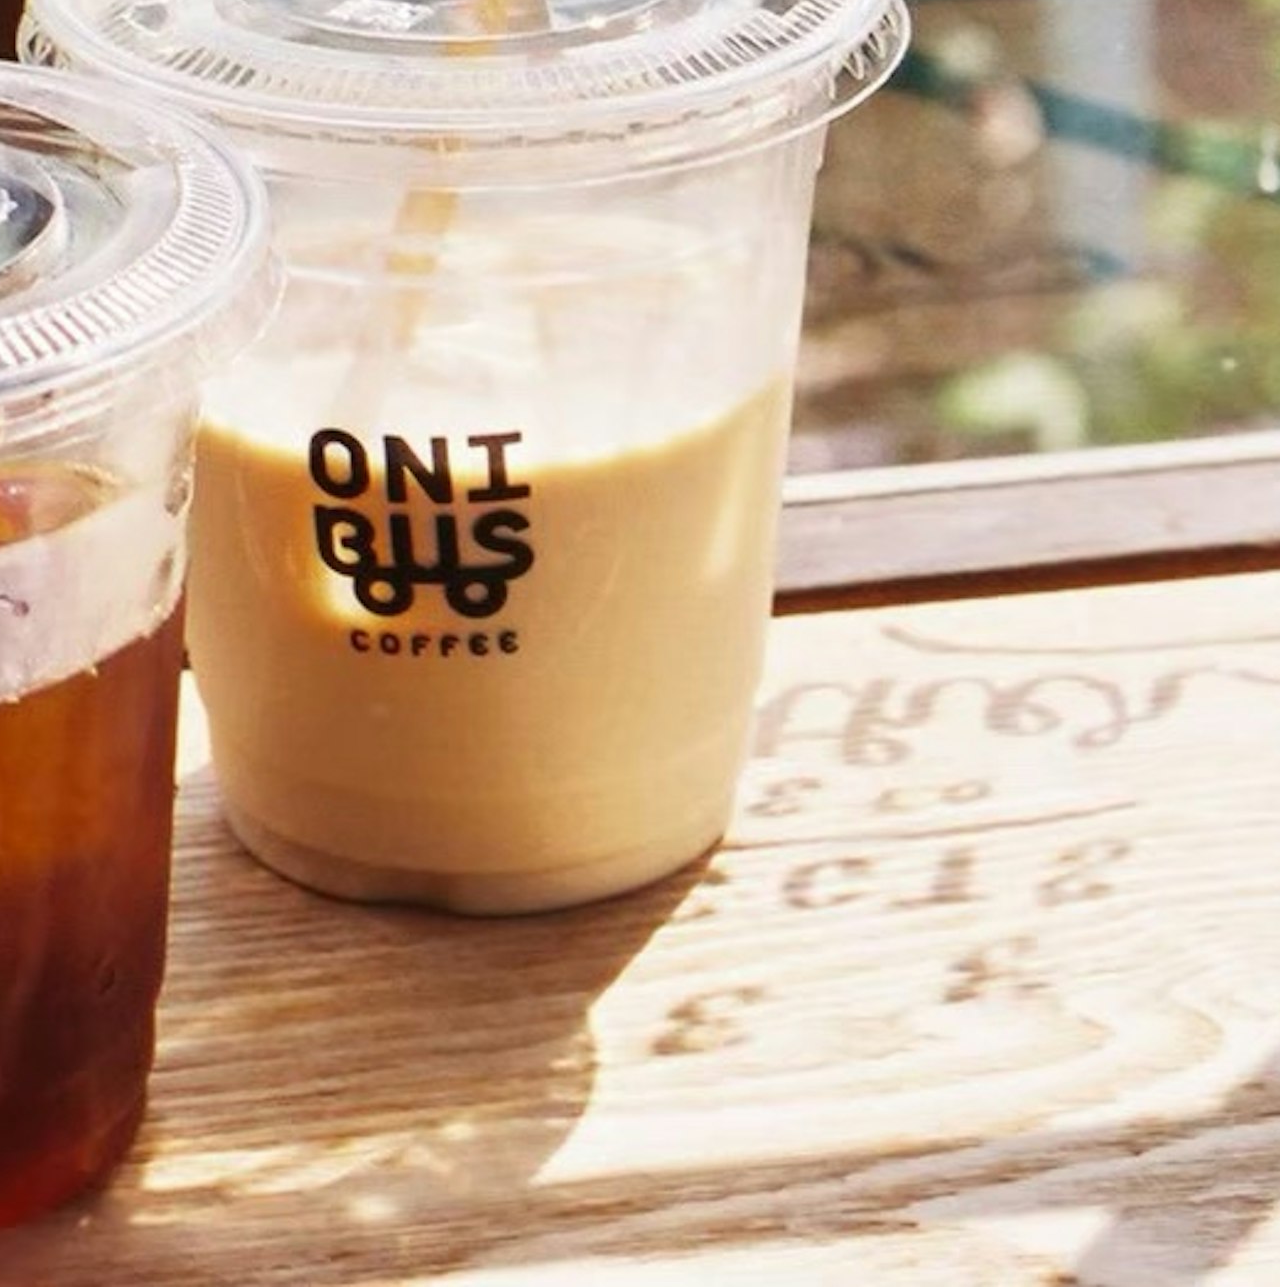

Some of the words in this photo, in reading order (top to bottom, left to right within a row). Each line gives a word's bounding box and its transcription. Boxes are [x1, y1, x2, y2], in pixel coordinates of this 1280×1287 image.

[308, 428, 531, 504] ONI
[313, 504, 535, 618] BUS
[350, 628, 519, 657] COFFEE
